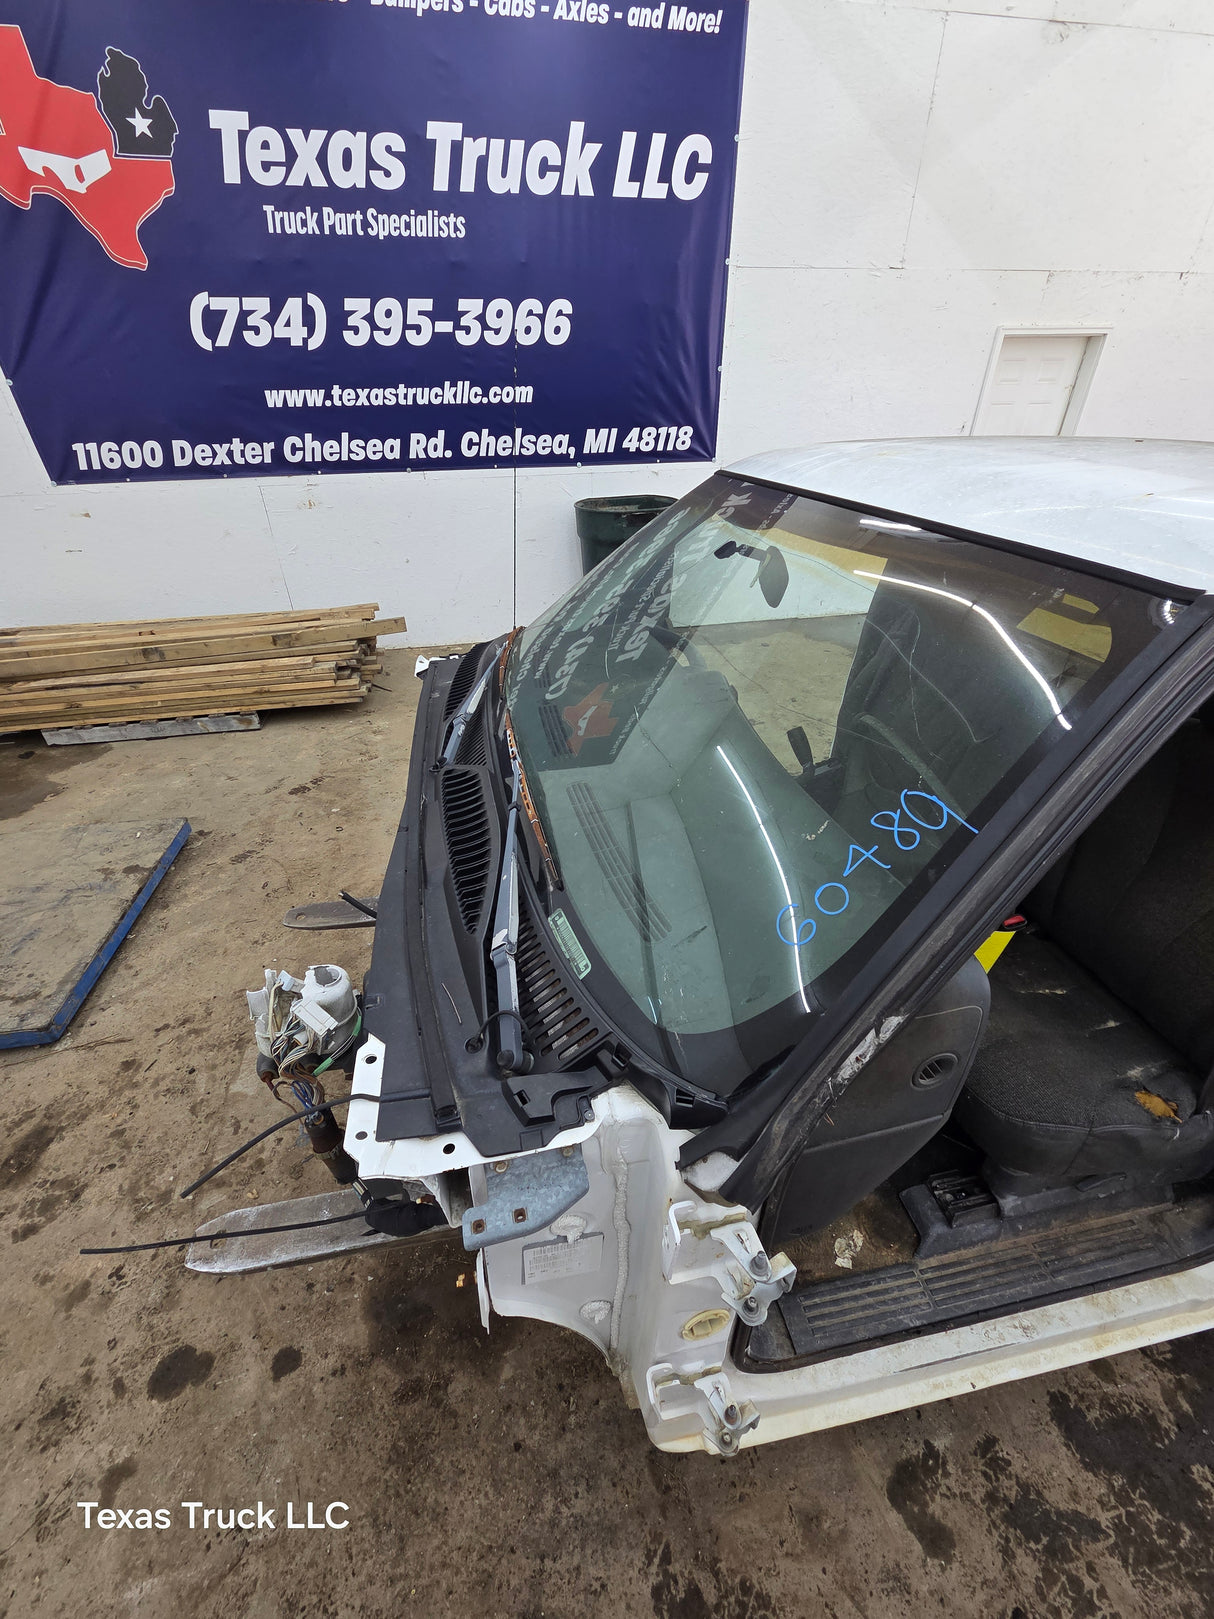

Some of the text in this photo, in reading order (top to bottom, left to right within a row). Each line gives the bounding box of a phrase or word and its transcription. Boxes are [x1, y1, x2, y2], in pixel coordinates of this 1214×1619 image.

[484, 0, 549, 18] Cabs
[553, 0, 609, 24] Axles
[628, 2, 665, 29] and
[668, 5, 723, 33] More!
[209, 109, 713, 200] Texas Truck LLC
[262, 204, 466, 239] Truck Part Specialists
[190, 292, 572, 351] (734) 395-3966
[264, 381, 533, 408] www.texastruckllc.com
[72, 425, 693, 470] 11600 Dexter Chelsea Rd. Chelsea, MI 48118
[777, 789, 979, 952] 60489
